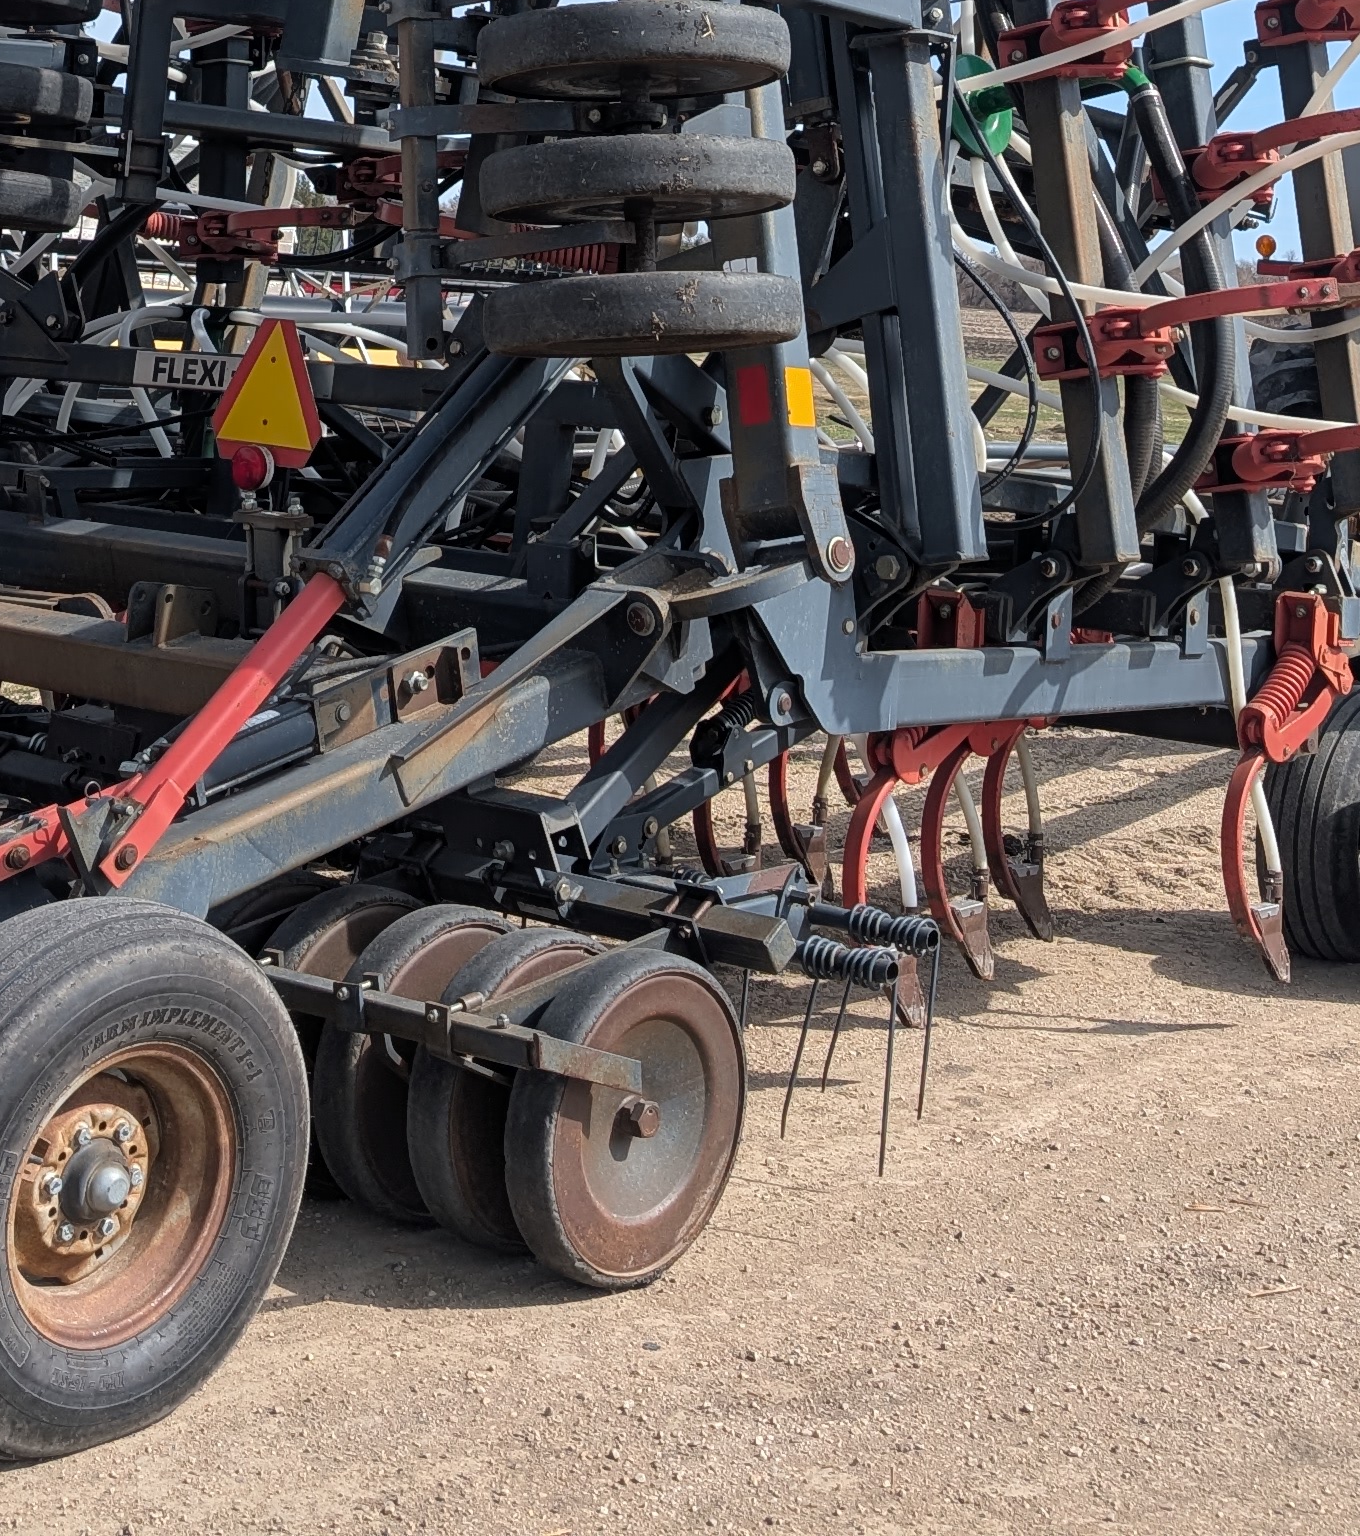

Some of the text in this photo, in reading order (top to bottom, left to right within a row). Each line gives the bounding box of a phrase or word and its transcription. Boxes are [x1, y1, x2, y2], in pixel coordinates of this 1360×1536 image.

[152, 356, 227, 388] FLEXI
[80, 1015, 139, 1062] FARM
[139, 1007, 247, 1057] IMPLEMENT
